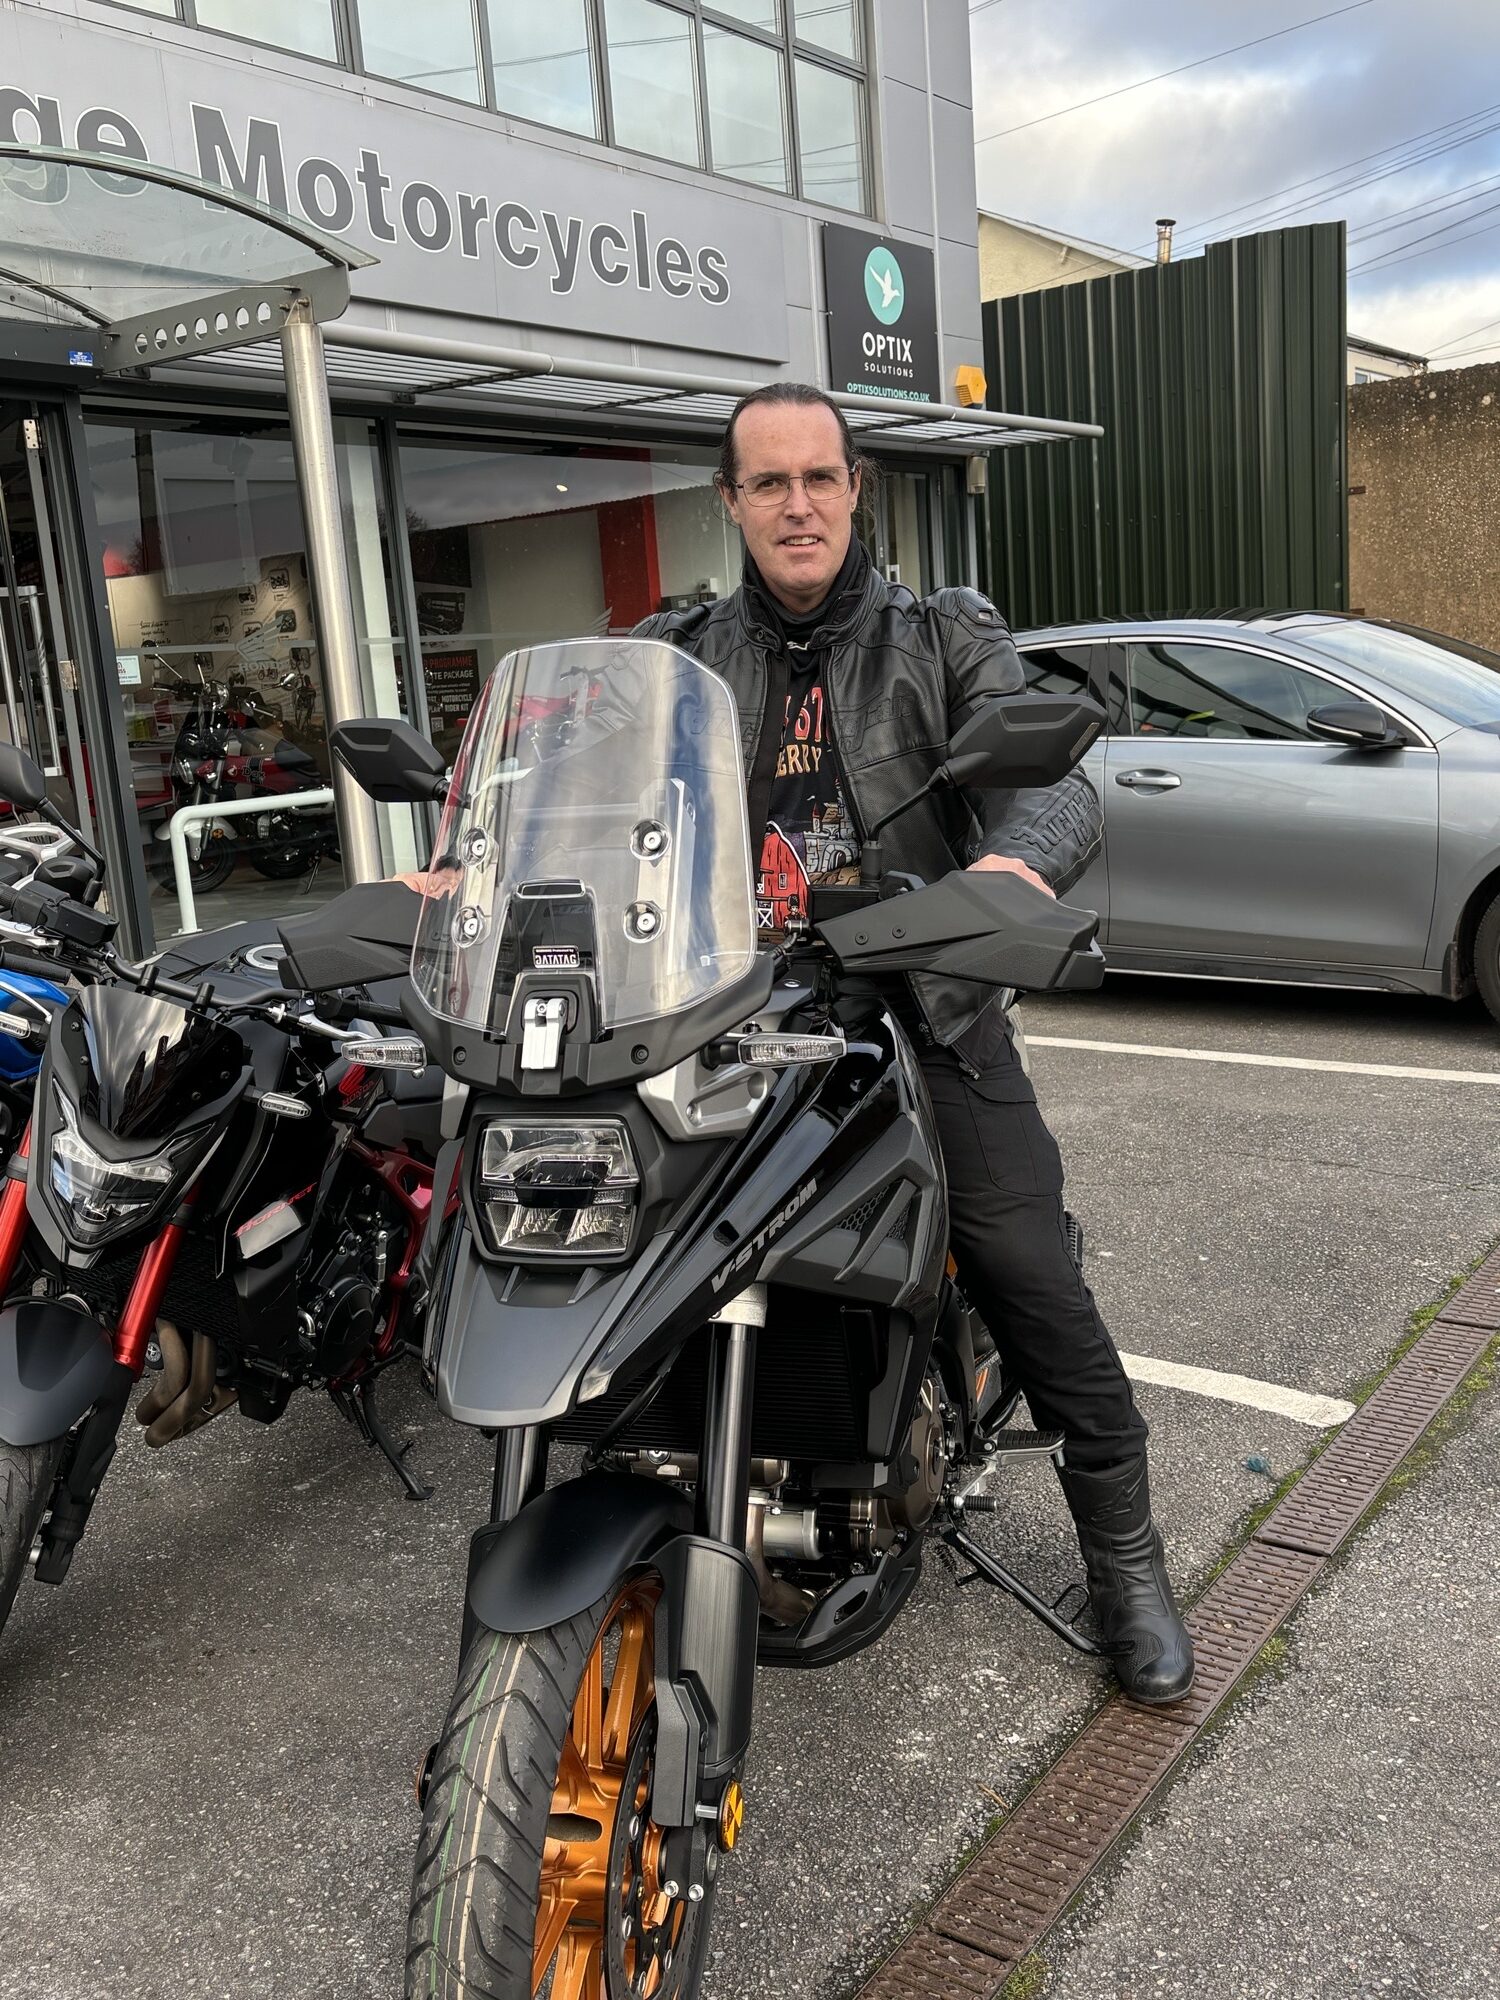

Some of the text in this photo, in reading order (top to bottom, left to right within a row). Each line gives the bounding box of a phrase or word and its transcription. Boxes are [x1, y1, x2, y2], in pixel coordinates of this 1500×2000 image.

[190, 101, 731, 306] Motorcycles
[862, 331, 913, 363] OPTIX
[864, 362, 914, 378] SOLUTIONS
[847, 382, 931, 403] OPTIXSOLUTIONS.CO.UK
[443, 669, 475, 680] PACKAGE
[535, 954, 577, 965] DATATAG
[711, 1177, 818, 1294] V-STROM
